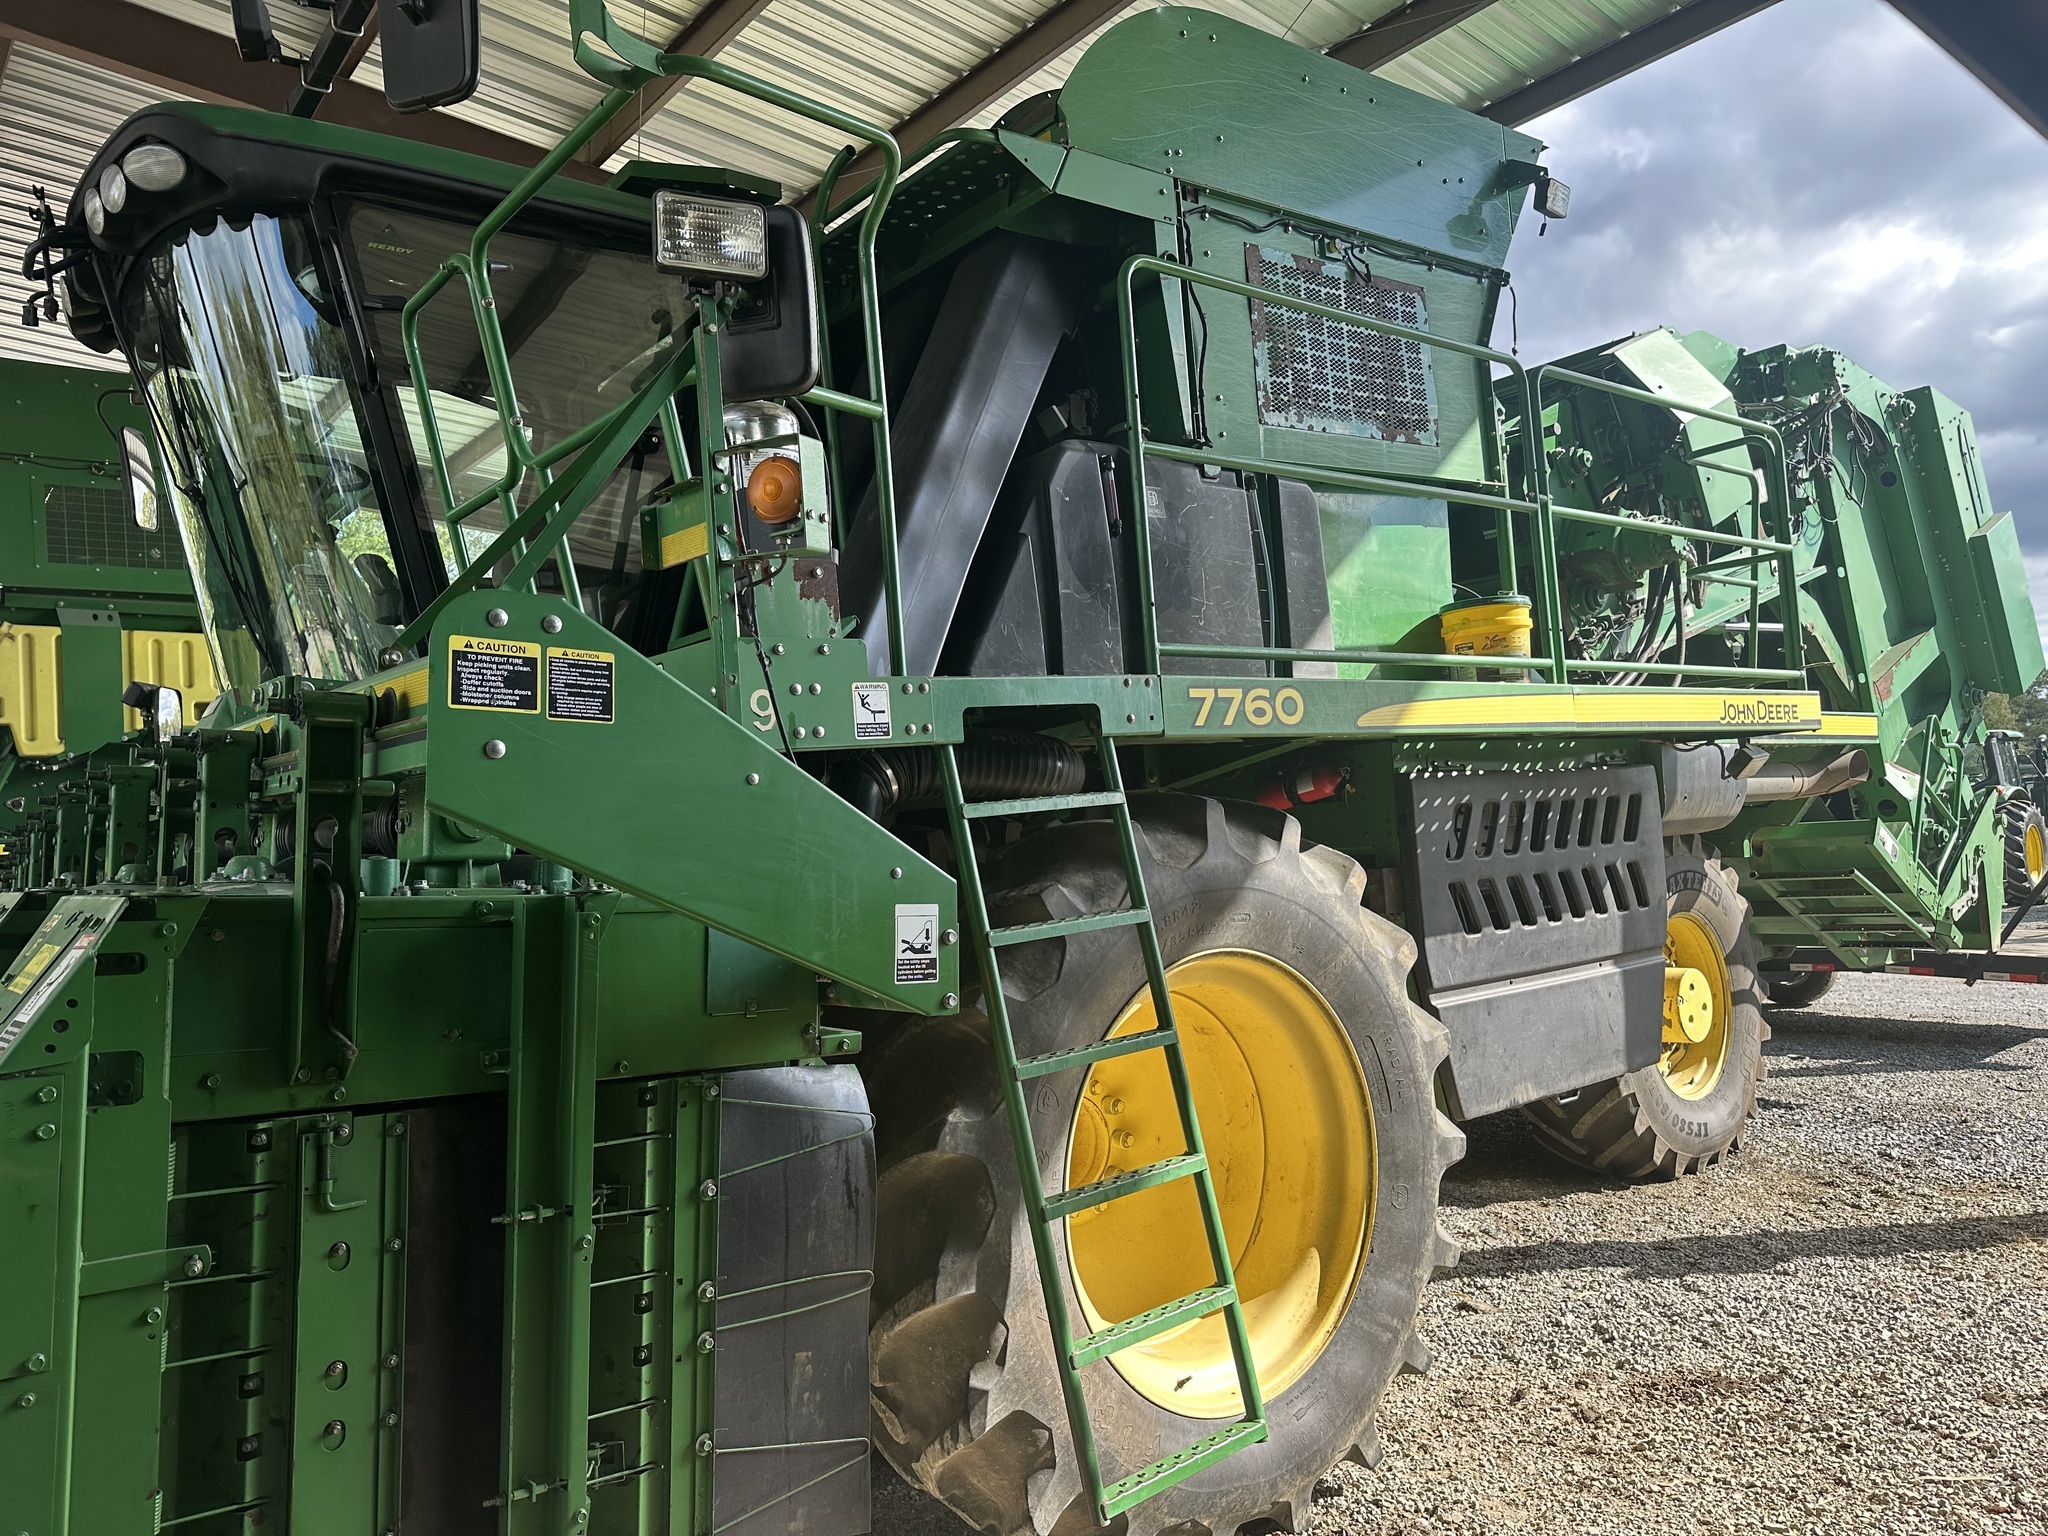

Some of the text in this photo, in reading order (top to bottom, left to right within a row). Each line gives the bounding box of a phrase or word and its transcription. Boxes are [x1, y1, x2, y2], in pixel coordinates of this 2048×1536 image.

[367, 242, 414, 254] READY
[476, 641, 526, 654] CAUTION
[478, 654, 508, 663] PREVENT
[571, 651, 600, 660] CAUTION
[474, 661, 497, 670] picking
[461, 672, 482, 680] Always
[480, 669, 510, 677] regularly.
[493, 693, 520, 701] columns
[750, 688, 777, 732] 9
[1187, 687, 1305, 728] 7760
[1720, 699, 1799, 721] JOHN DEERE
[1383, 1034, 1407, 1099] RADIAL
